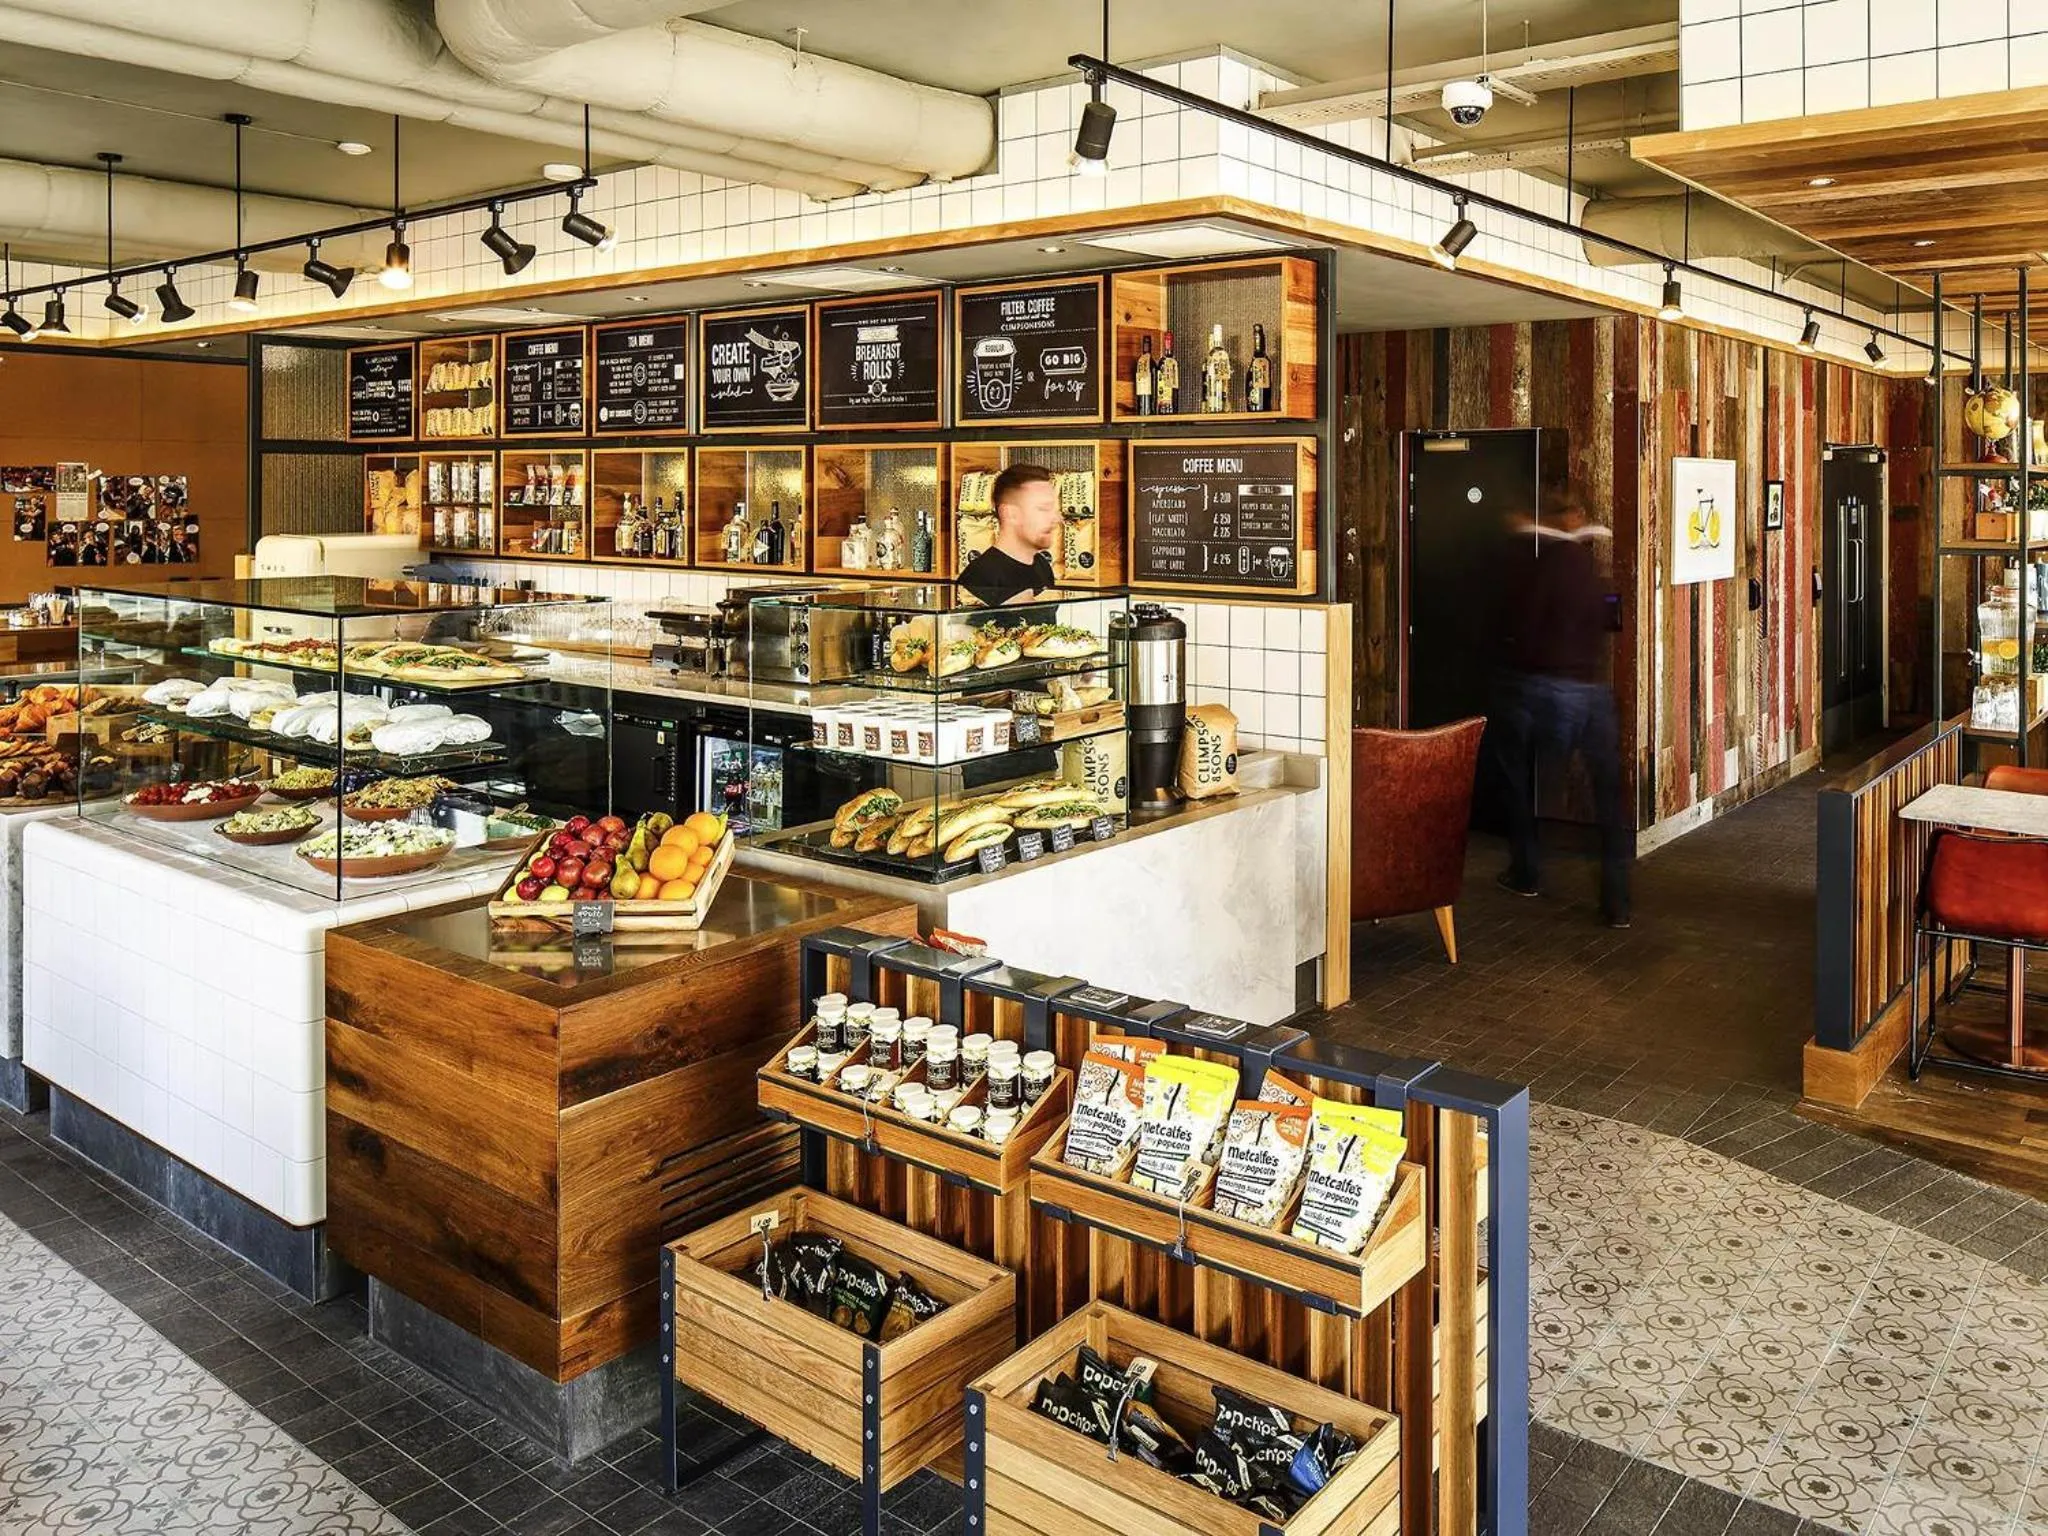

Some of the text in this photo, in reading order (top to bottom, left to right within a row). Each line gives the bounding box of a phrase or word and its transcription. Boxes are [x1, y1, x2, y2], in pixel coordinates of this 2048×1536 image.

[1001, 298, 1055, 315] FILTER COFFEE
[712, 342, 750, 366] CREATE
[856, 343, 901, 361] BREAKFAST
[1045, 354, 1080, 366] GO BIG
[712, 367, 750, 384] YOUR OWN
[863, 360, 892, 380] ROLLS
[1044, 379, 1086, 402] for 50p
[1183, 458, 1243, 472] COFFEE MENU
[1152, 528, 1186, 537] MACCHIATO
[1092, 1120, 1122, 1137] popcorn
[1157, 1138, 1190, 1152] popcorn
[1245, 1164, 1276, 1176] popcorn
[1324, 1190, 1358, 1208] popcorn
